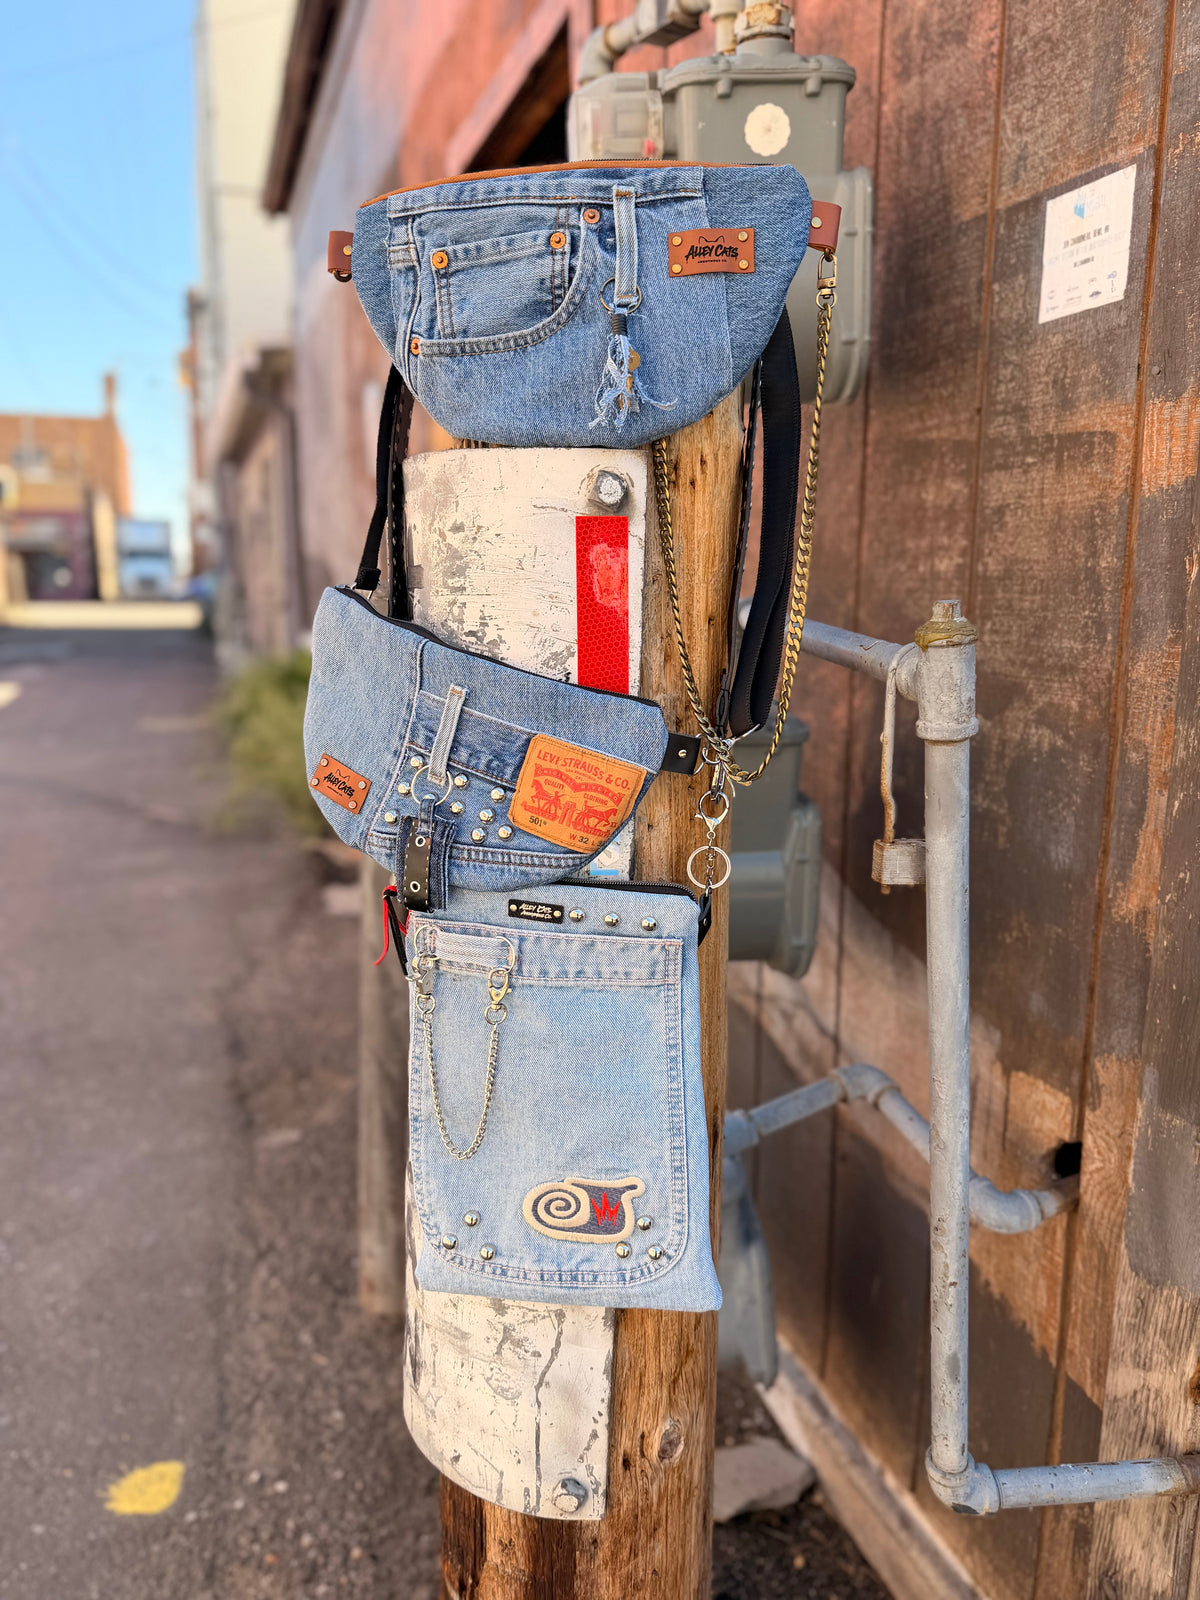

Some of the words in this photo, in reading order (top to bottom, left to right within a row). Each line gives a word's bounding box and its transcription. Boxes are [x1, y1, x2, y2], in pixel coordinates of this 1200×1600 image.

[537, 749, 560, 766] LEVI
[561, 757, 605, 782] STRAUSS
[605, 774, 614, 785] &
[614, 777, 631, 791] CO.
[544, 779, 565, 791] QUALITY
[583, 793, 609, 806] CLOTHING
[569, 833, 577, 841] W
[578, 836, 589, 845] 32
